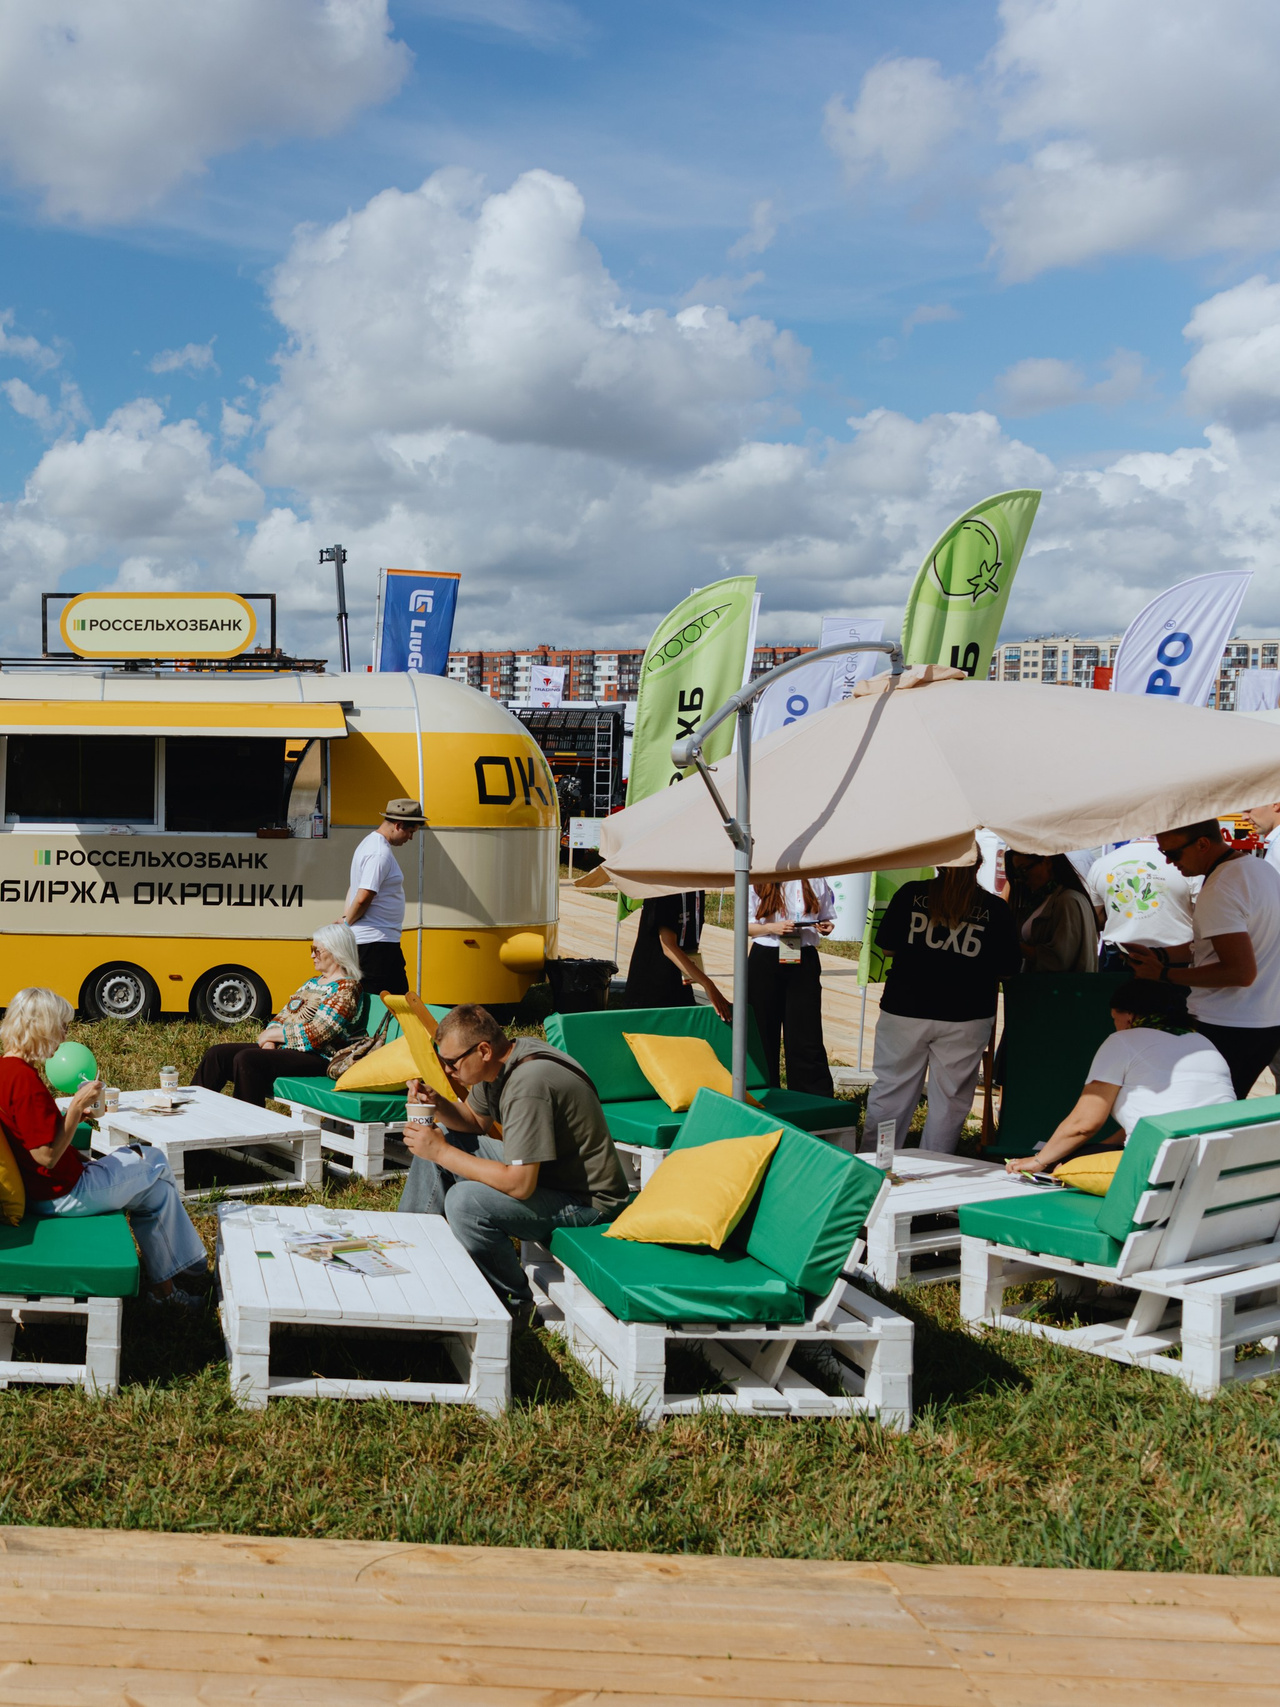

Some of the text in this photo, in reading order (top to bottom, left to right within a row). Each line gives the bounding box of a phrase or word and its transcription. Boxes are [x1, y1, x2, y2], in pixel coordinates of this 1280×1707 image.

[89, 619, 243, 632] РОССЕЛЬХОЗБАНК
[56, 849, 269, 869] РОССЕЛЬХОЗБАНК
[0, 879, 304, 908] БИРЖА ОКРОШКИ
[907, 911, 986, 958] РСХБ
